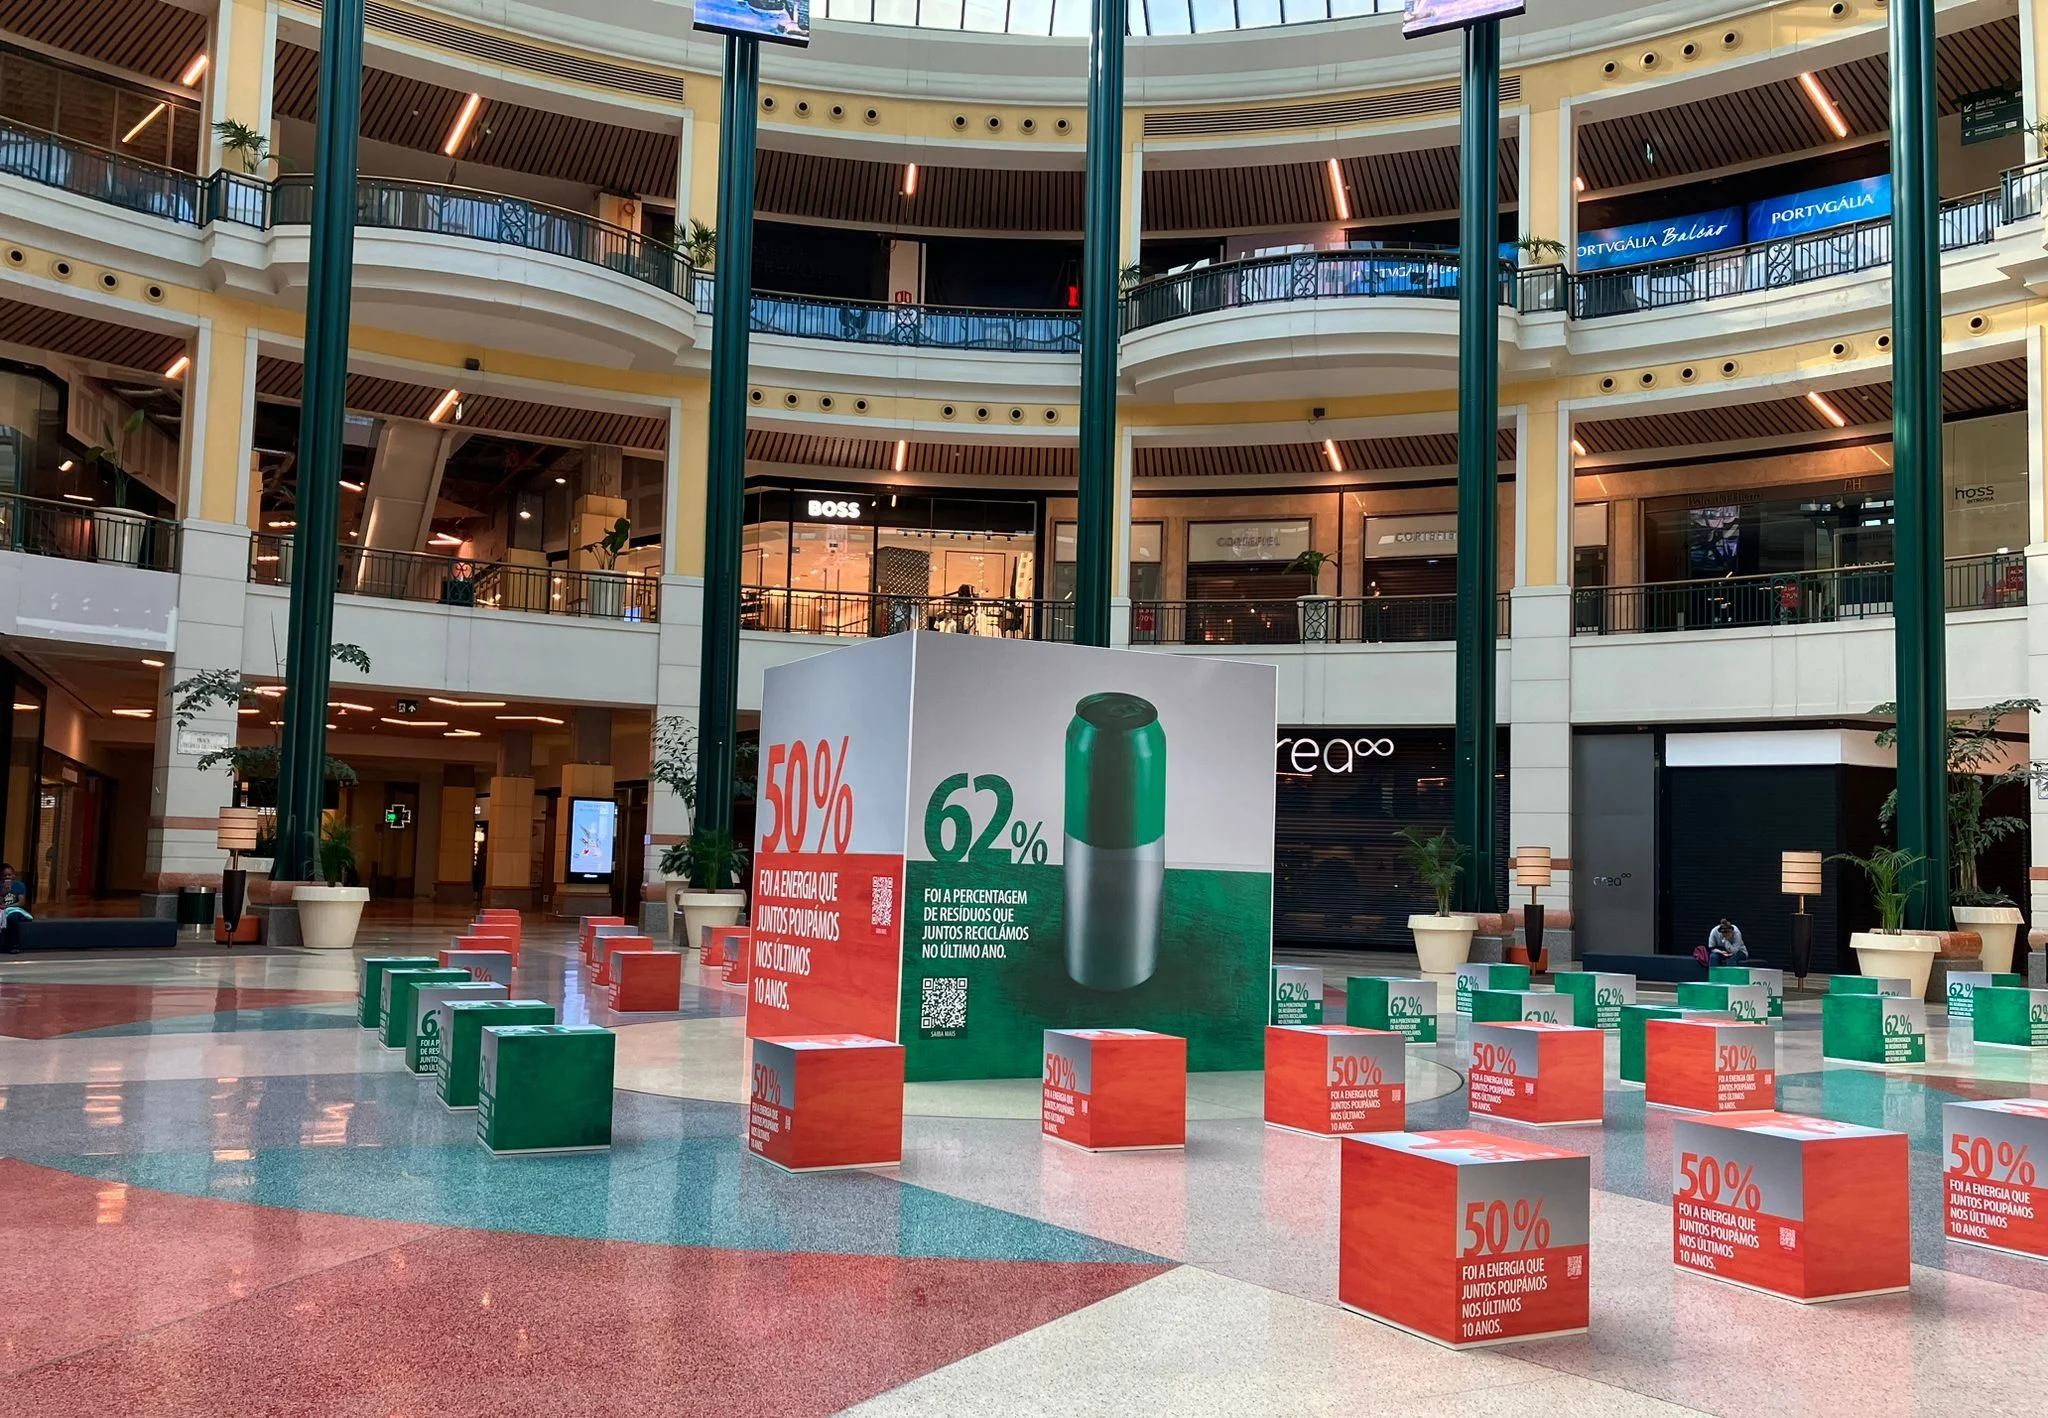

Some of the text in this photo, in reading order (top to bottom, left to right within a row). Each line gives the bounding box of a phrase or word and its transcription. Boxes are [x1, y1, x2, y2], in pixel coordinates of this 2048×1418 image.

[1771, 193, 1874, 225] PORTVGÁLIA
[1577, 223, 1728, 257] ORTVGÁLIA Balcão
[1955, 486, 1994, 499] hoss
[808, 500, 861, 519] BOSS
[1395, 530, 1457, 542] CORTEFIE
[761, 736, 854, 853] 50%
[924, 772, 1048, 863] 62%
[759, 869, 838, 904] FOI A ENERGIA QUE
[924, 888, 1027, 905] FOI A PERCENTAGEM
[757, 904, 840, 941] JUNTOS POUPÁMOS
[924, 904, 1014, 923] DE RESÍDUOS QUE
[922, 923, 1029, 940] JUNTOS RECICLÁMOS
[755, 940, 772, 969] NOS
[773, 938, 811, 976] ÚLTIMOS
[922, 941, 1007, 959] NO ÚLTIMO ANO.
[754, 977, 790, 1010] 10 ANOS.
[1279, 982, 1309, 1000] 62%
[1597, 988, 1624, 1005] 62%
[1391, 996, 1422, 1016] 62%
[1885, 1014, 1912, 1034] 62%
[1332, 1055, 1382, 1086] 50%
[1472, 1042, 1516, 1074] 50%
[1719, 1045, 1757, 1071] 50%
[1045, 1052, 1076, 1090] 50%
[753, 1064, 780, 1105] 50%
[1950, 1133, 2035, 1186] 50%
[1679, 1152, 1761, 1212] 50%
[1949, 1179, 2031, 1204] FOI A ENERGIA QUE
[1679, 1202, 1756, 1232] FOI A ENERGIA QUE
[1949, 1193, 2034, 1219] JUNTOS POUPÁMOS
[1950, 1207, 2008, 1229] NOS ÚLTIMOS
[1463, 1197, 1550, 1256] 50%
[1679, 1218, 1760, 1249] JUNTOS POUPÁMOS
[1951, 1222, 1989, 1240] 10 ANOS.
[1679, 1233, 1734, 1258] NOS ÚLTIMOS
[1462, 1257, 1545, 1281] FOI A ENERGIA QUE
[1680, 1249, 1717, 1270] 10 ANOS.
[1461, 1275, 1548, 1300] JUNTOS POUPÁMOS
[1462, 1297, 1522, 1319] NOS ÚLTIMOS
[1462, 1318, 1503, 1338] 10 ANOS.
